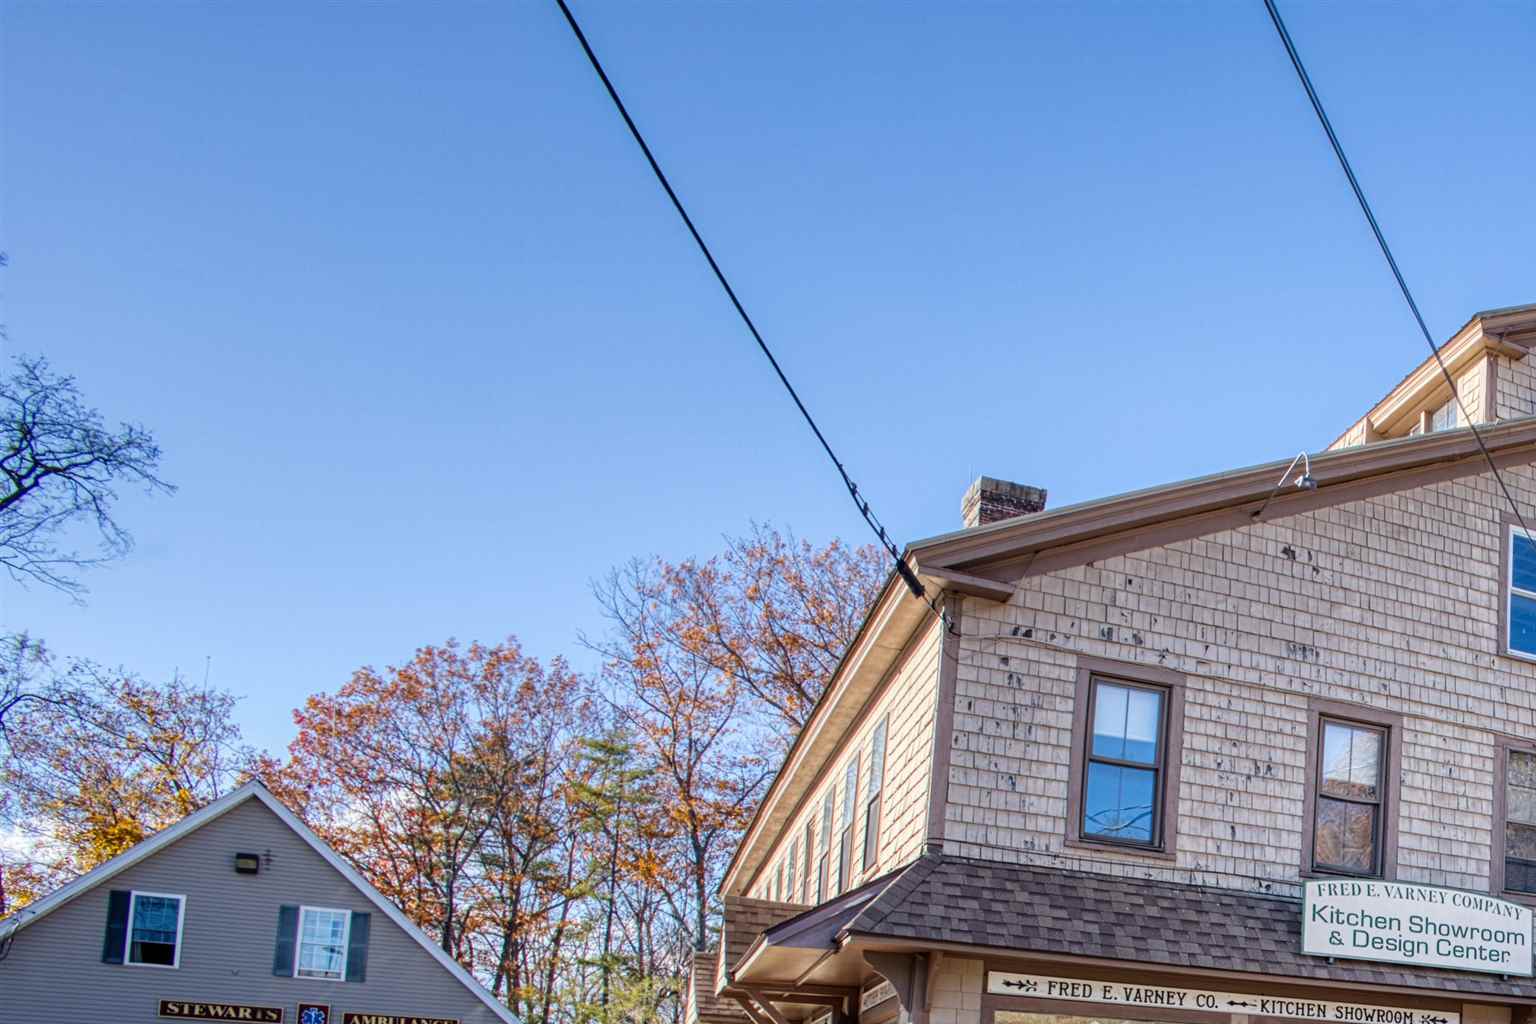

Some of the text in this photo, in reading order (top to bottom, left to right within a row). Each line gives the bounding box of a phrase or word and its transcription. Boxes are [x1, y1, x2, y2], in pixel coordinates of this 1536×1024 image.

[1317, 883, 1523, 921] FRED E. VARNEY COMPANY
[1311, 904, 1525, 946] Kitchen Showroom
[1329, 931, 1345, 946] &
[1353, 930, 1429, 957] Design
[1047, 980, 1413, 1024] FRED E. VARNEY CO. KITCHEN SHOWROOM
